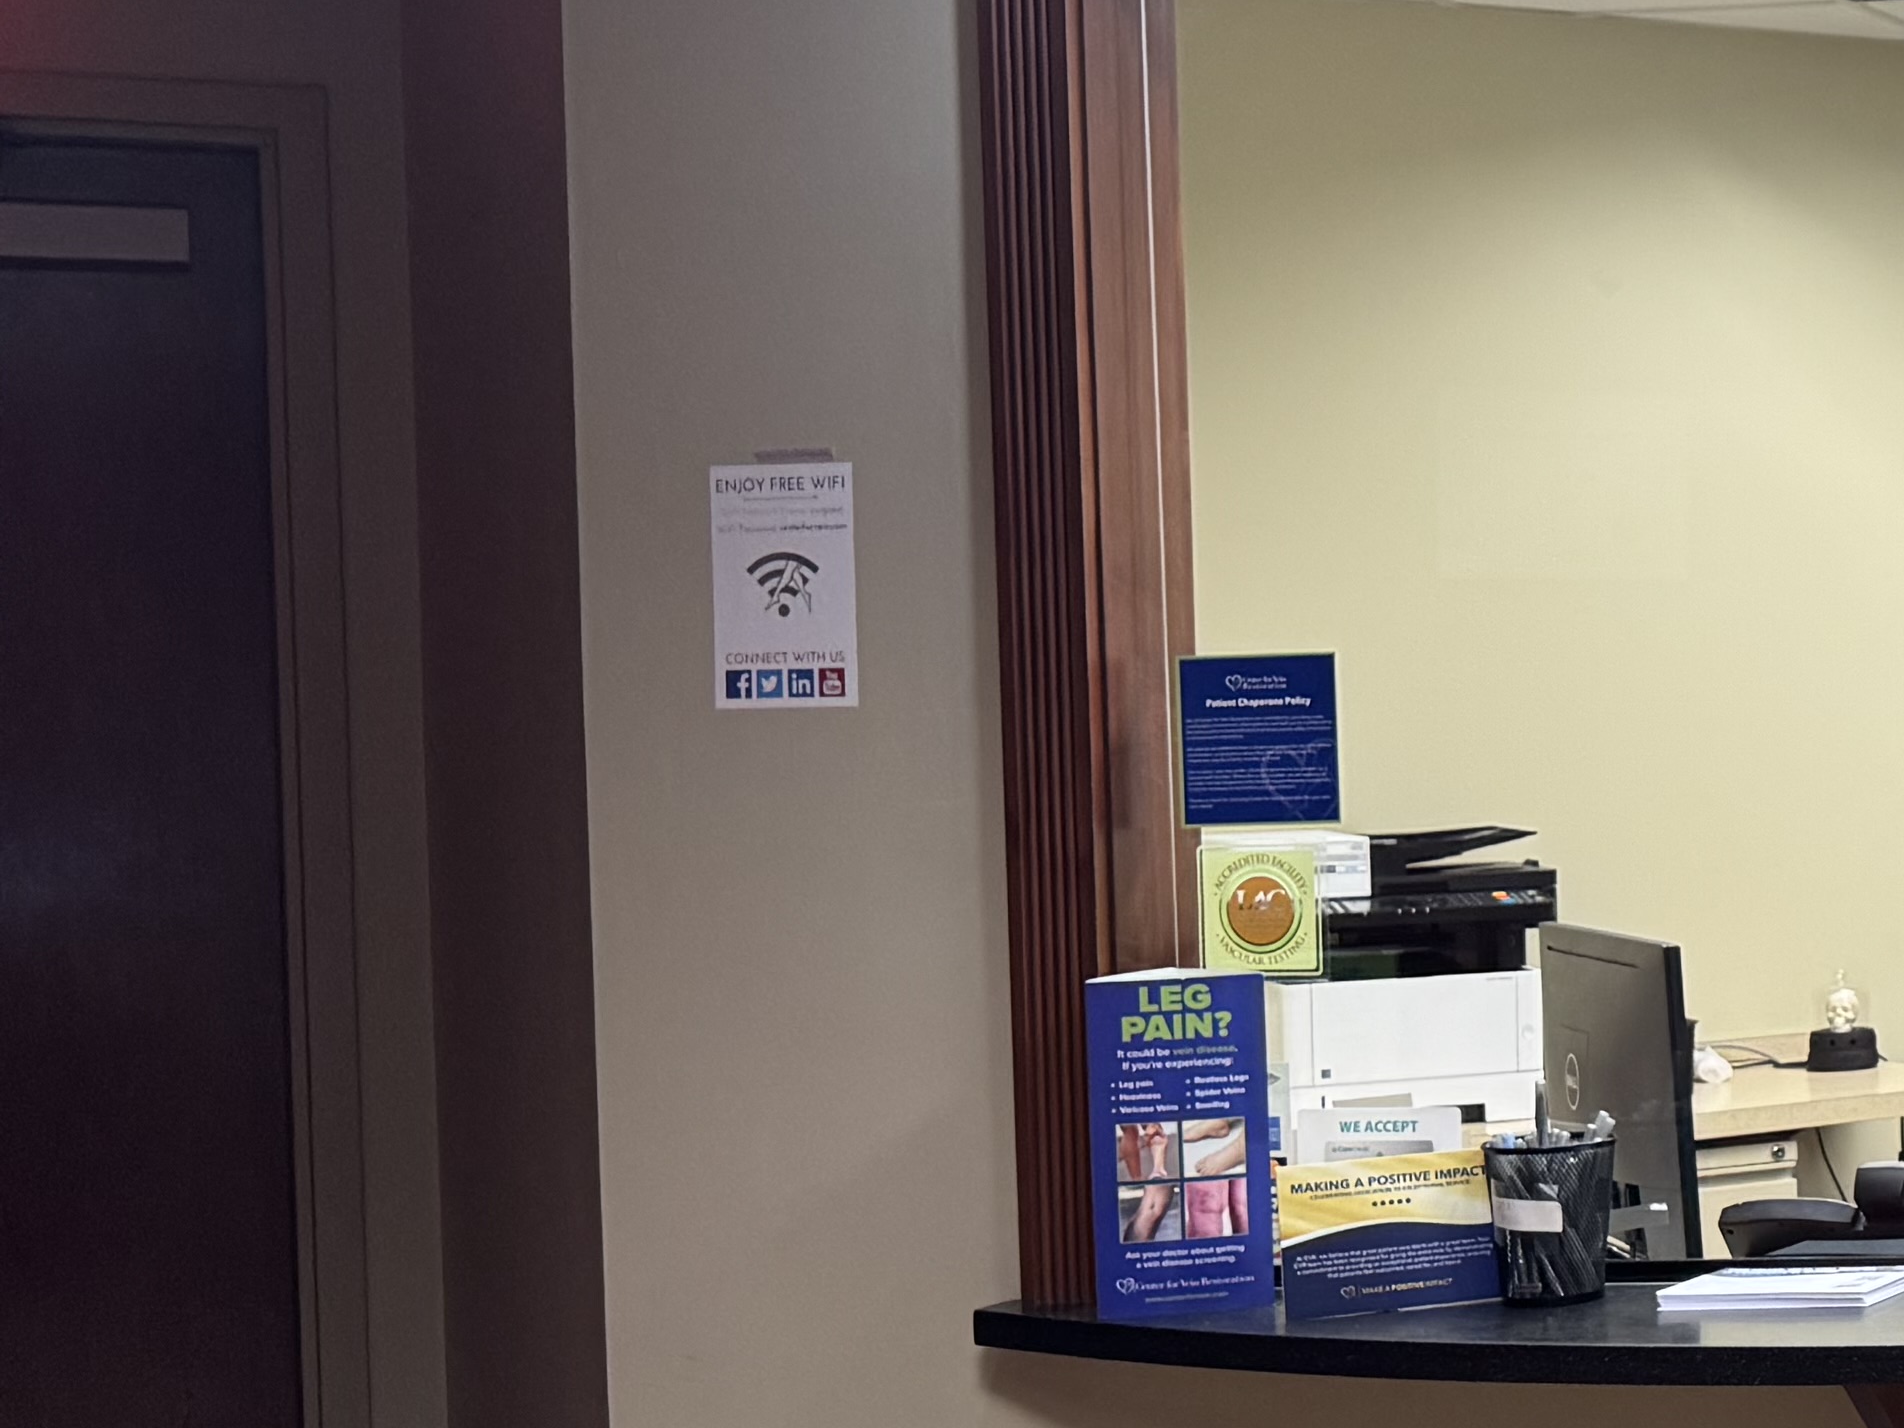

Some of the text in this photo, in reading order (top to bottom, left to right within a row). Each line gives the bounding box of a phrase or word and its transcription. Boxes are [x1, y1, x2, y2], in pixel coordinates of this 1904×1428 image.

[716, 475, 845, 493] ENJOY FREE WIFI
[725, 651, 845, 664] CONNECT WITH US
[1138, 983, 1212, 1013] LEG
[1121, 1011, 1232, 1043] PAIN?
[1117, 1050, 1124, 1058] It
[1127, 1048, 1155, 1058] could
[1157, 1048, 1170, 1057] be
[1122, 1061, 1130, 1070] If
[1339, 1120, 1419, 1133] WE ACCEPT
[1290, 1179, 1350, 1195] MAKING
[1354, 1178, 1364, 1187] A
[1368, 1170, 1431, 1187] POSITIVE
[1434, 1165, 1486, 1180] IMPACT
